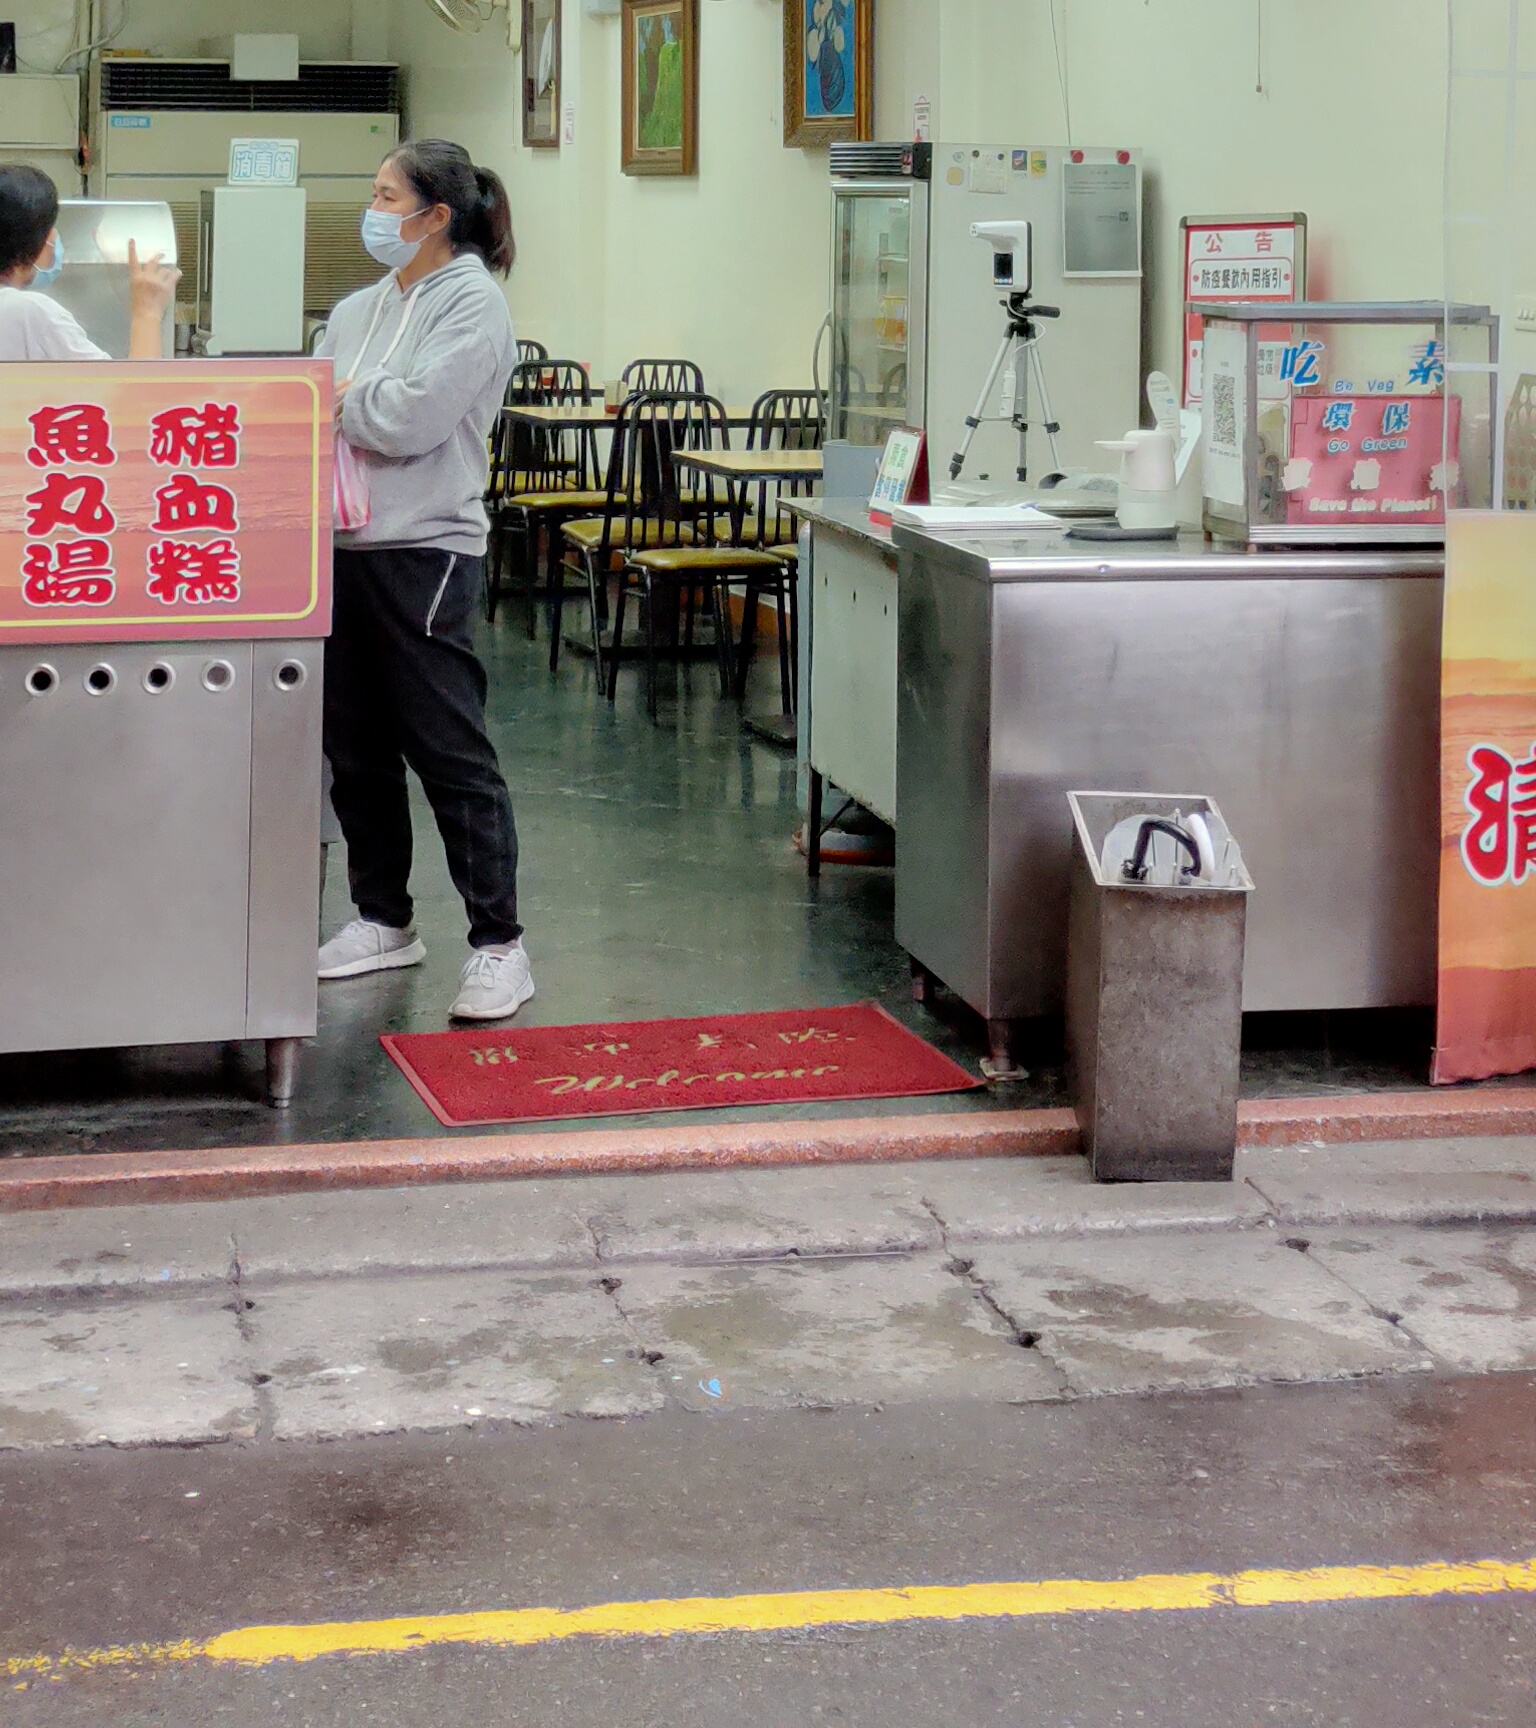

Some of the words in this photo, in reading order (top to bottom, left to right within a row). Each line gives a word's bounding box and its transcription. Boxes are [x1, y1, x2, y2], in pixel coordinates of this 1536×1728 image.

[1205, 232, 1273, 253] 公告
[1279, 340, 1445, 386] 吃素
[1334, 380, 1353, 392] Be
[1367, 380, 1394, 393] Veg
[1323, 402, 1410, 435] 環保
[22, 404, 116, 605] 魚丸湯
[148, 403, 241, 604] 豬血糕
